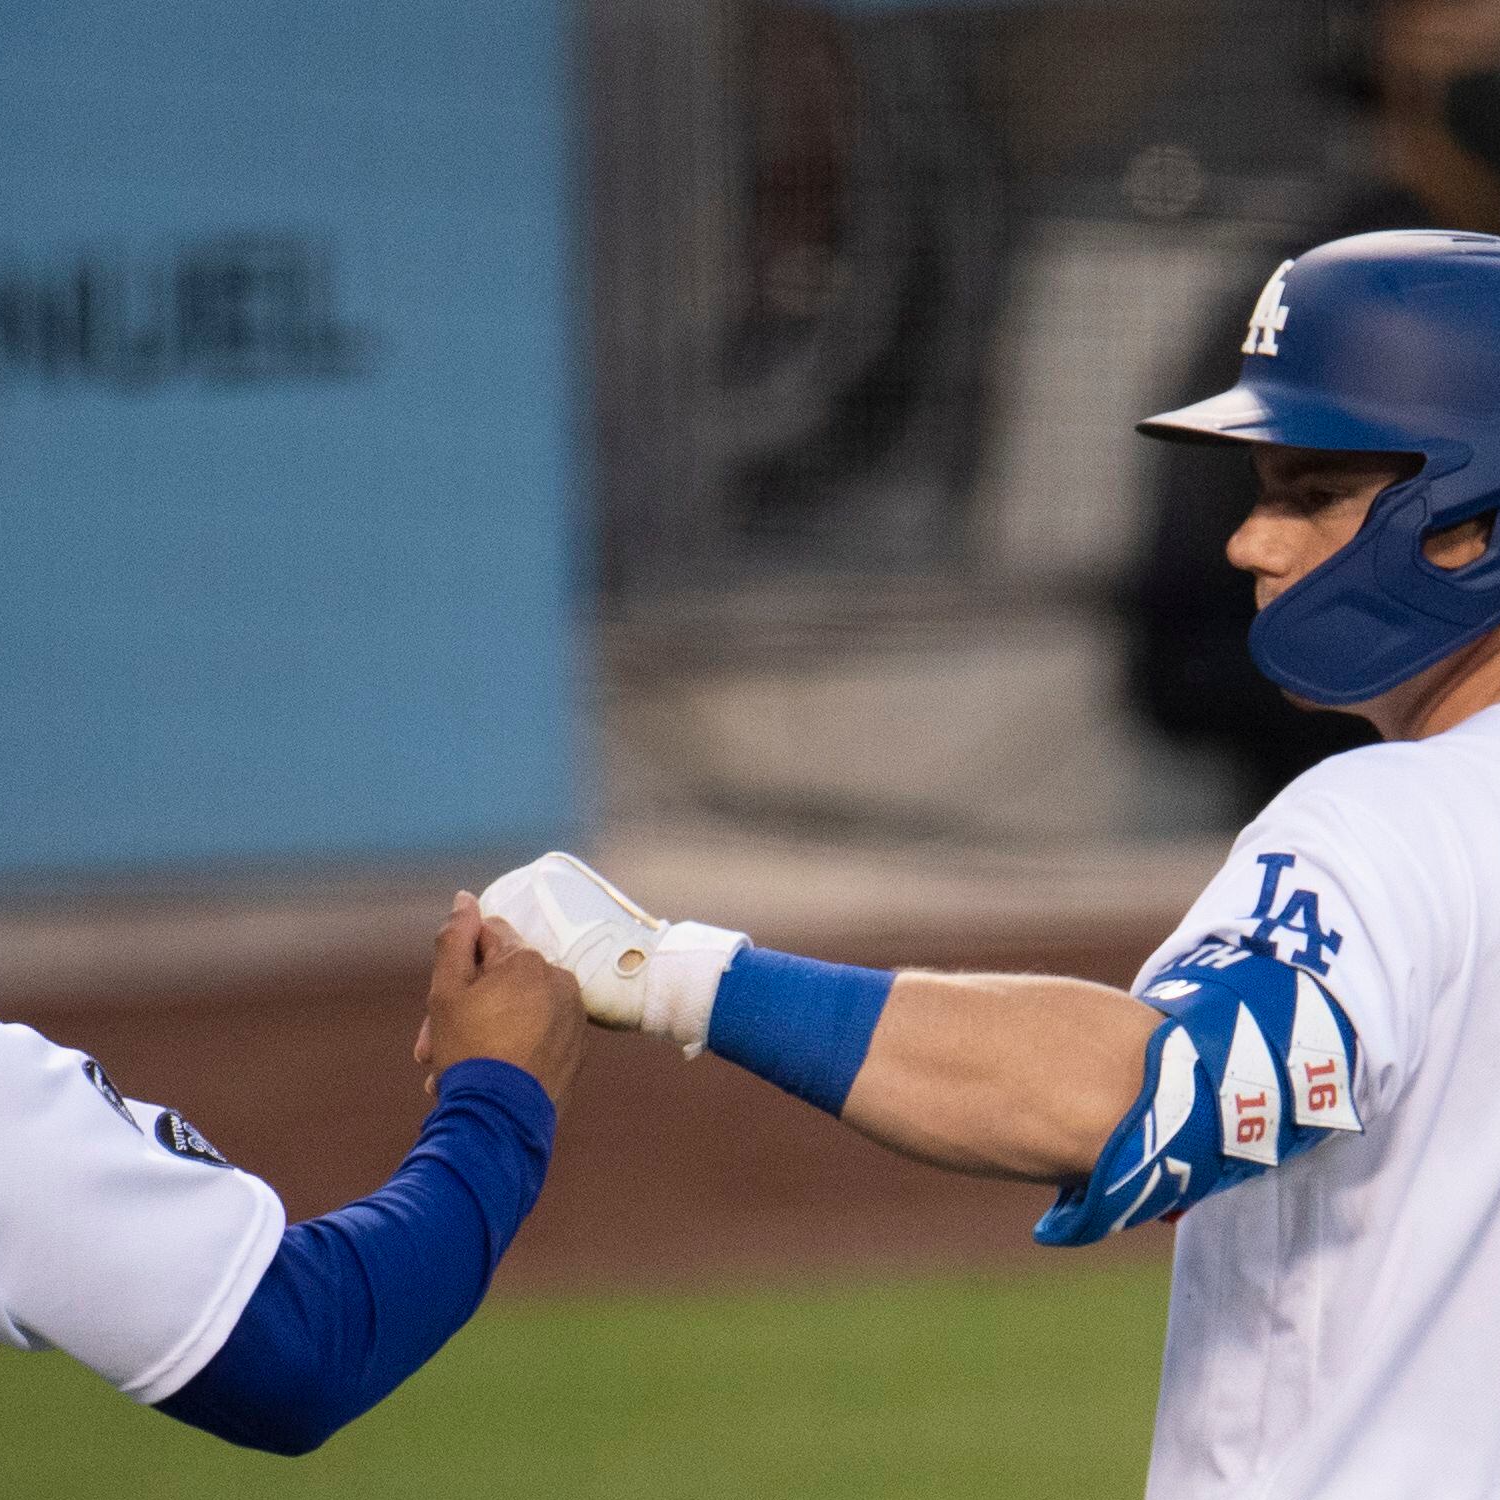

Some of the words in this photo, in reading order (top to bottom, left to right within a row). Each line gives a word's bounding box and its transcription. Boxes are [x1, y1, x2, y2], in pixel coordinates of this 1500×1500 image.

[1238, 852, 1343, 977] LA
[1304, 1058, 1337, 1111] 16
[1235, 1091, 1266, 1144] 16
